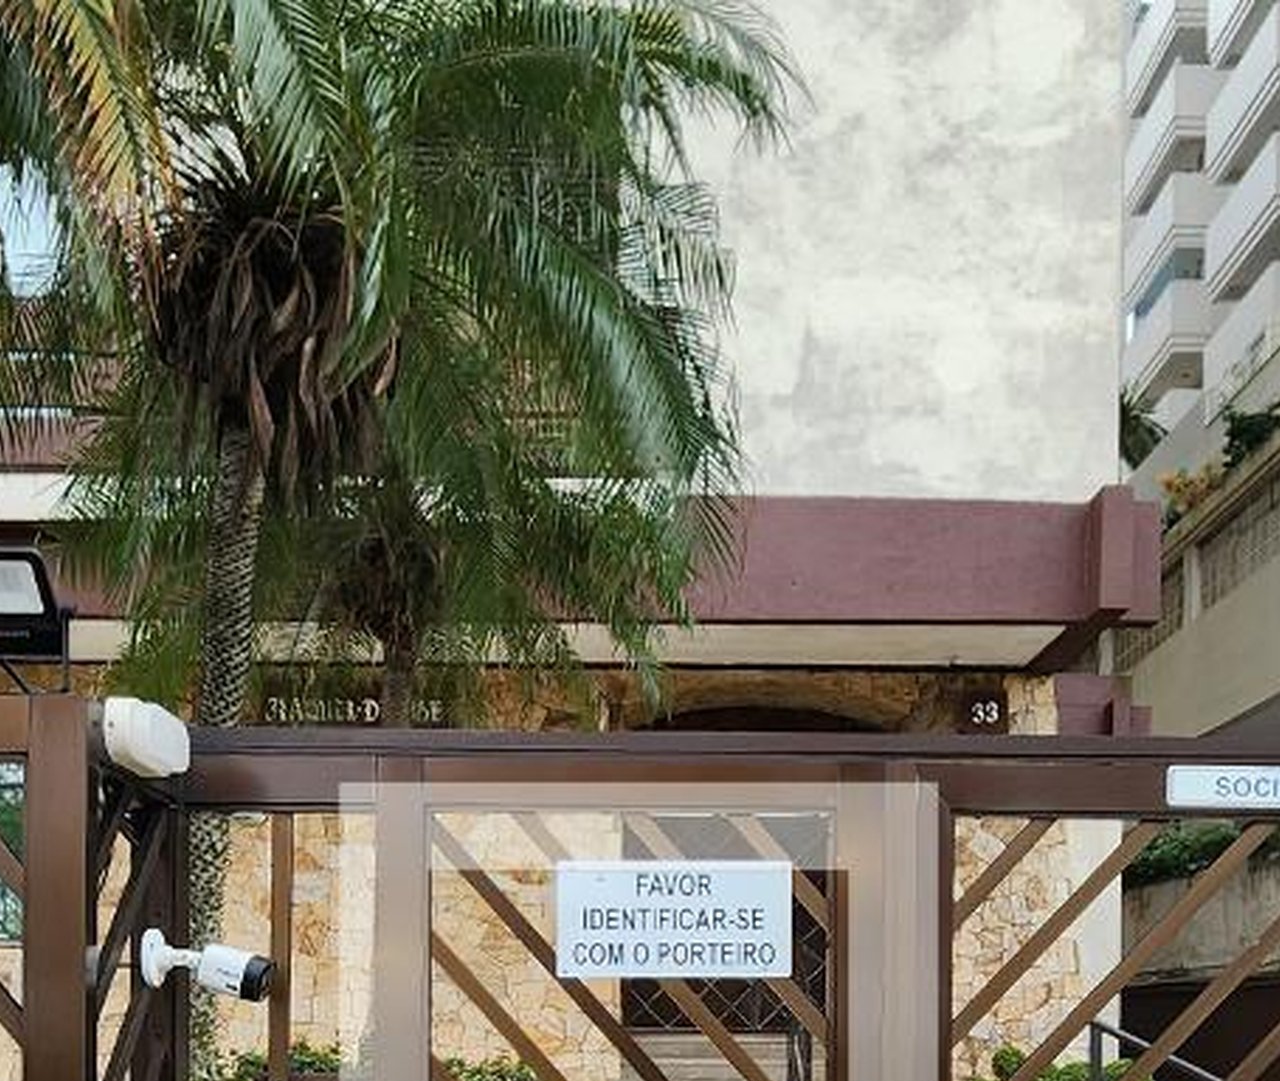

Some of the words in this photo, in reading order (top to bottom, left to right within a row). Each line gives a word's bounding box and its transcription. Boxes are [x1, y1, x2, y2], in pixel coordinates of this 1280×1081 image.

[972, 700, 999, 724] 33
[636, 873, 712, 897] FAVOR
[582, 907, 765, 931] IDENTIFICAR-SE
[572, 942, 625, 966] COM
[633, 942, 650, 966] O
[658, 942, 776, 966] PORTEIRO
